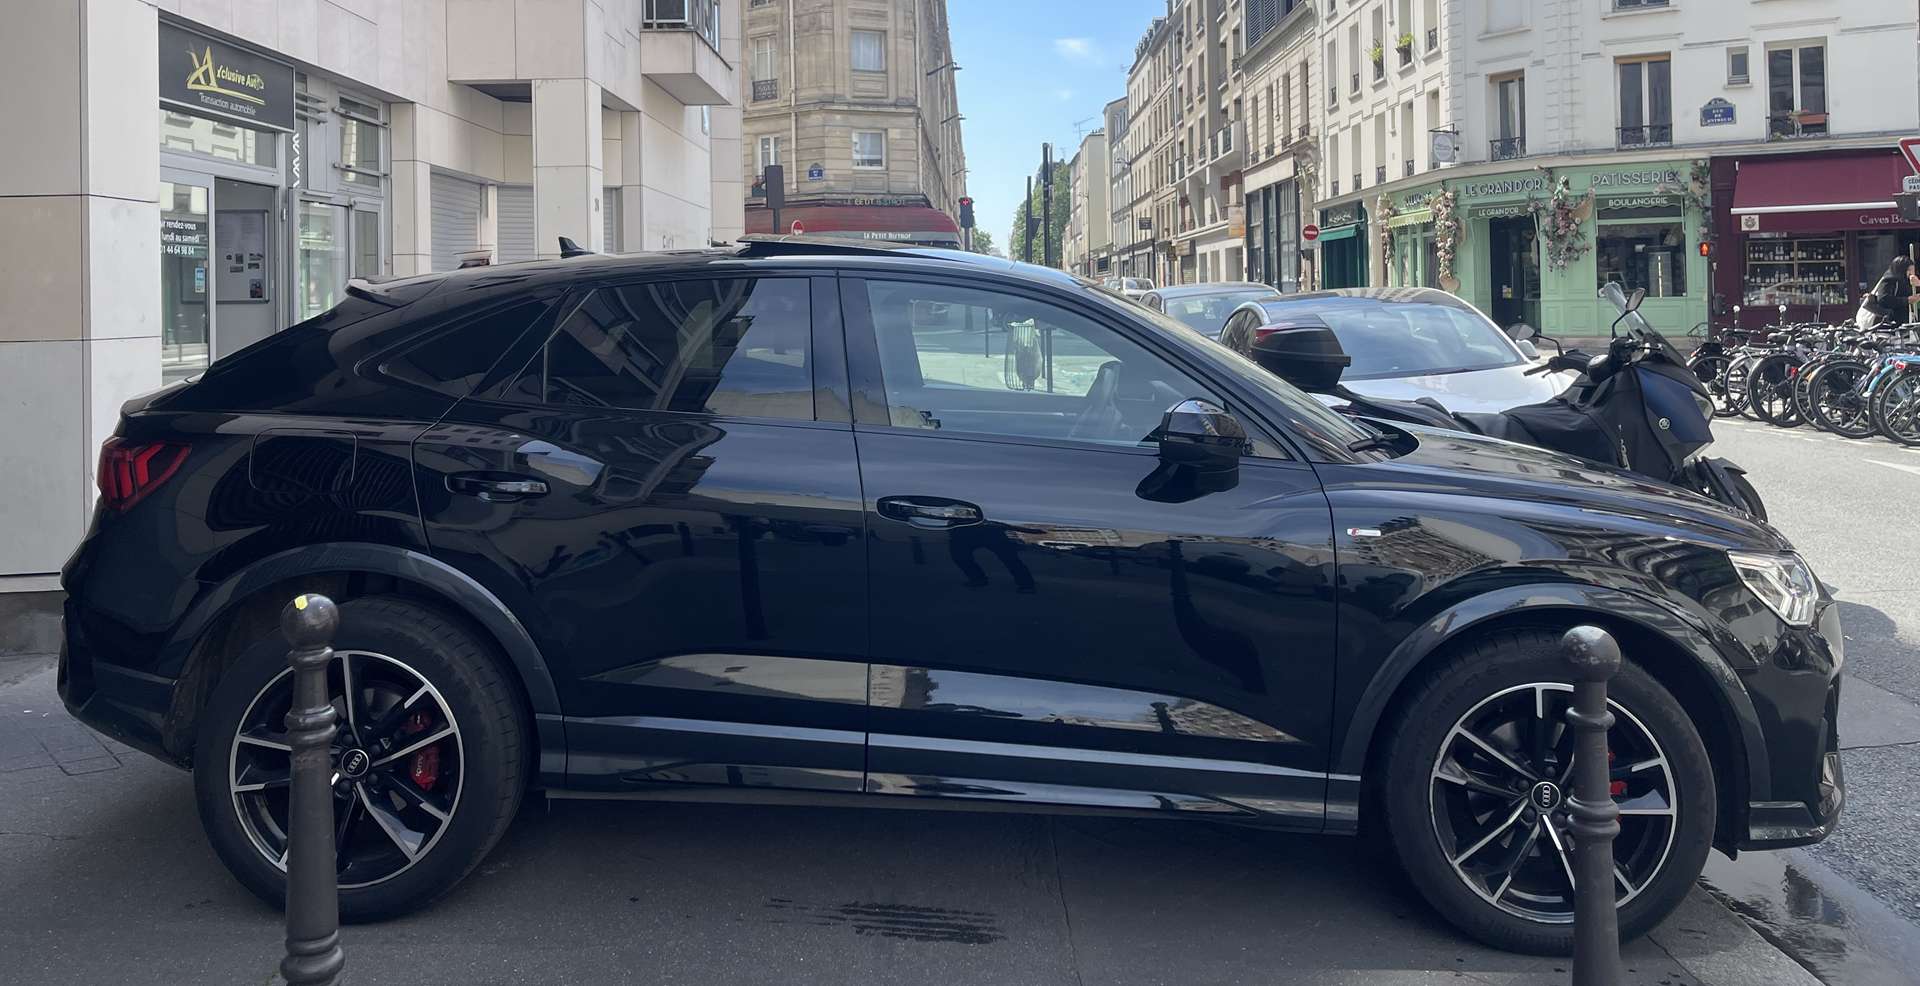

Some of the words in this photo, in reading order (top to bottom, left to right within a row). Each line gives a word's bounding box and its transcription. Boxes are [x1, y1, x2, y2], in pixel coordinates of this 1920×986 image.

[199, 92, 229, 109] Transaction
[229, 102, 256, 115] automobile
[1592, 170, 1675, 186] PATISSERIE
[1464, 184, 1477, 197] LE
[1479, 177, 1542, 196] GRAND'OR
[1608, 196, 1669, 207] BOULANGERIE
[1478, 208, 1486, 216] LE
[1486, 207, 1519, 216] GRAND'OR
[1859, 214, 1889, 225] Caves
